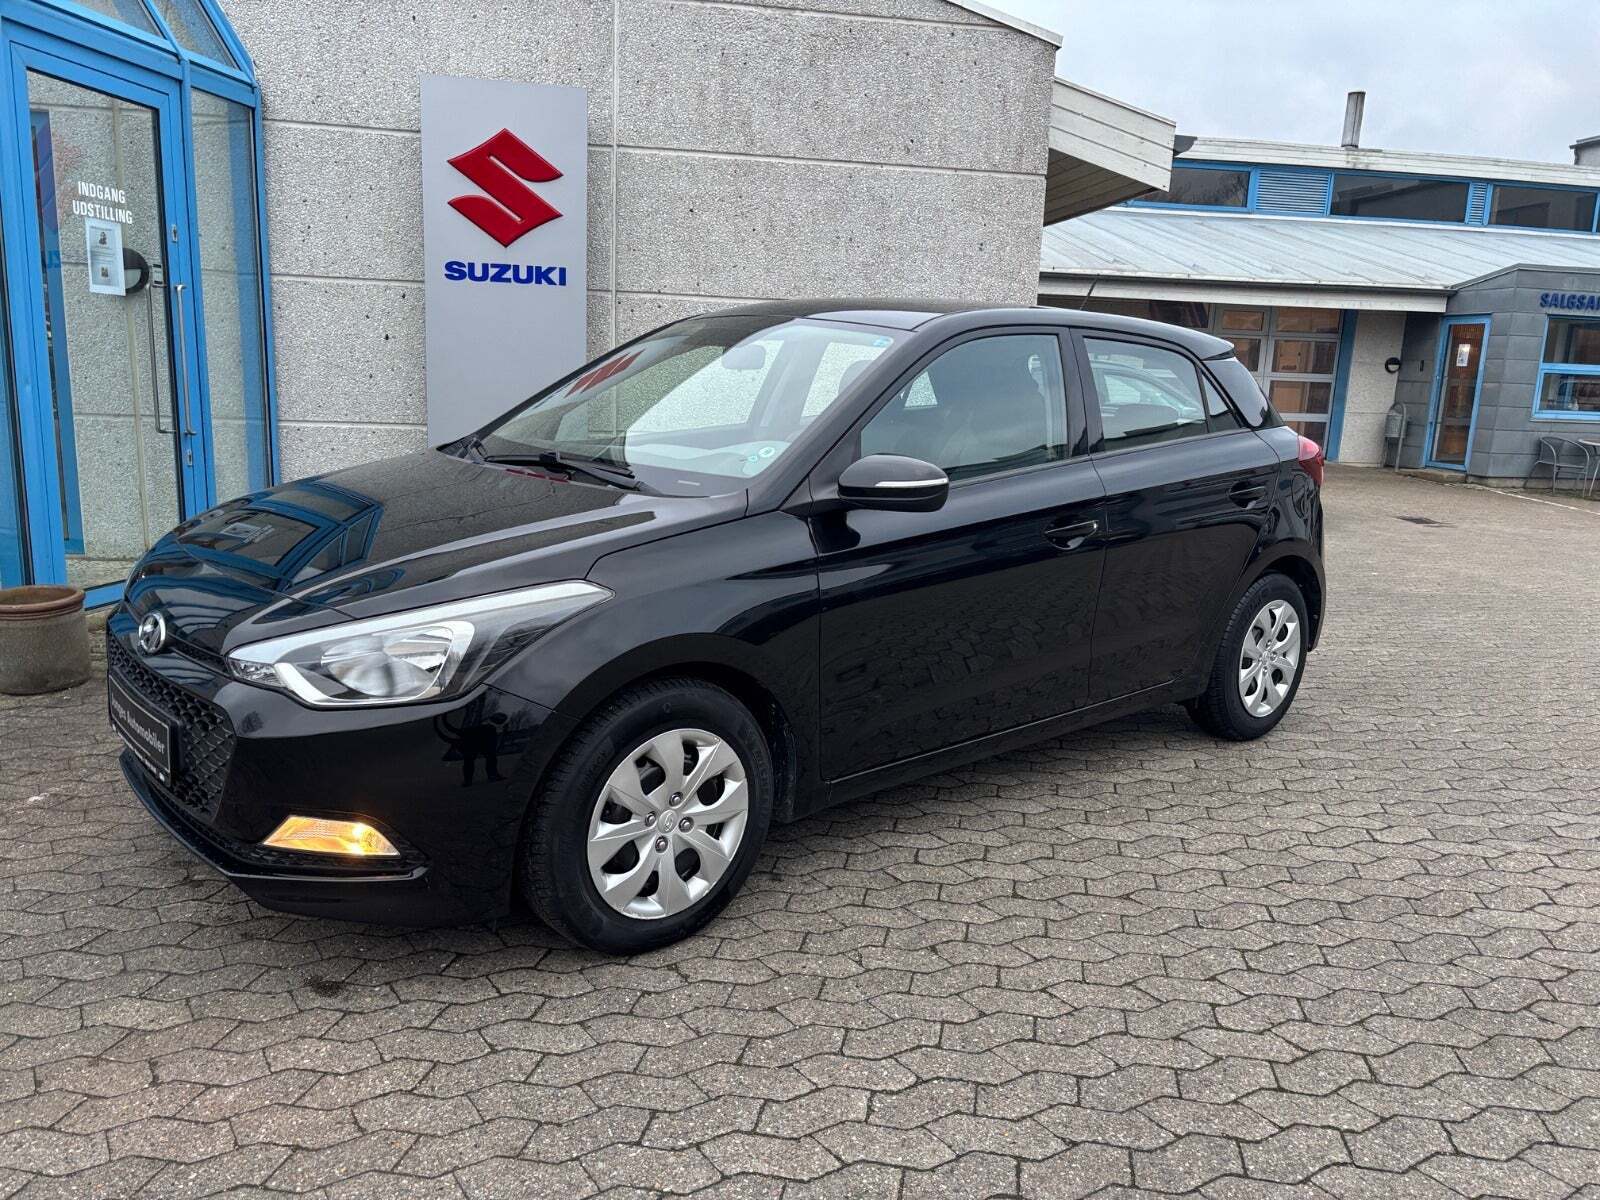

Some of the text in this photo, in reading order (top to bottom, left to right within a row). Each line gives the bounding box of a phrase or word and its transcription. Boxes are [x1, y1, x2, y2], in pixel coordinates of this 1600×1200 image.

[78, 181, 126, 204] INDGANG
[72, 199, 133, 225] UDSTILLING
[444, 260, 567, 286] SUZUKI
